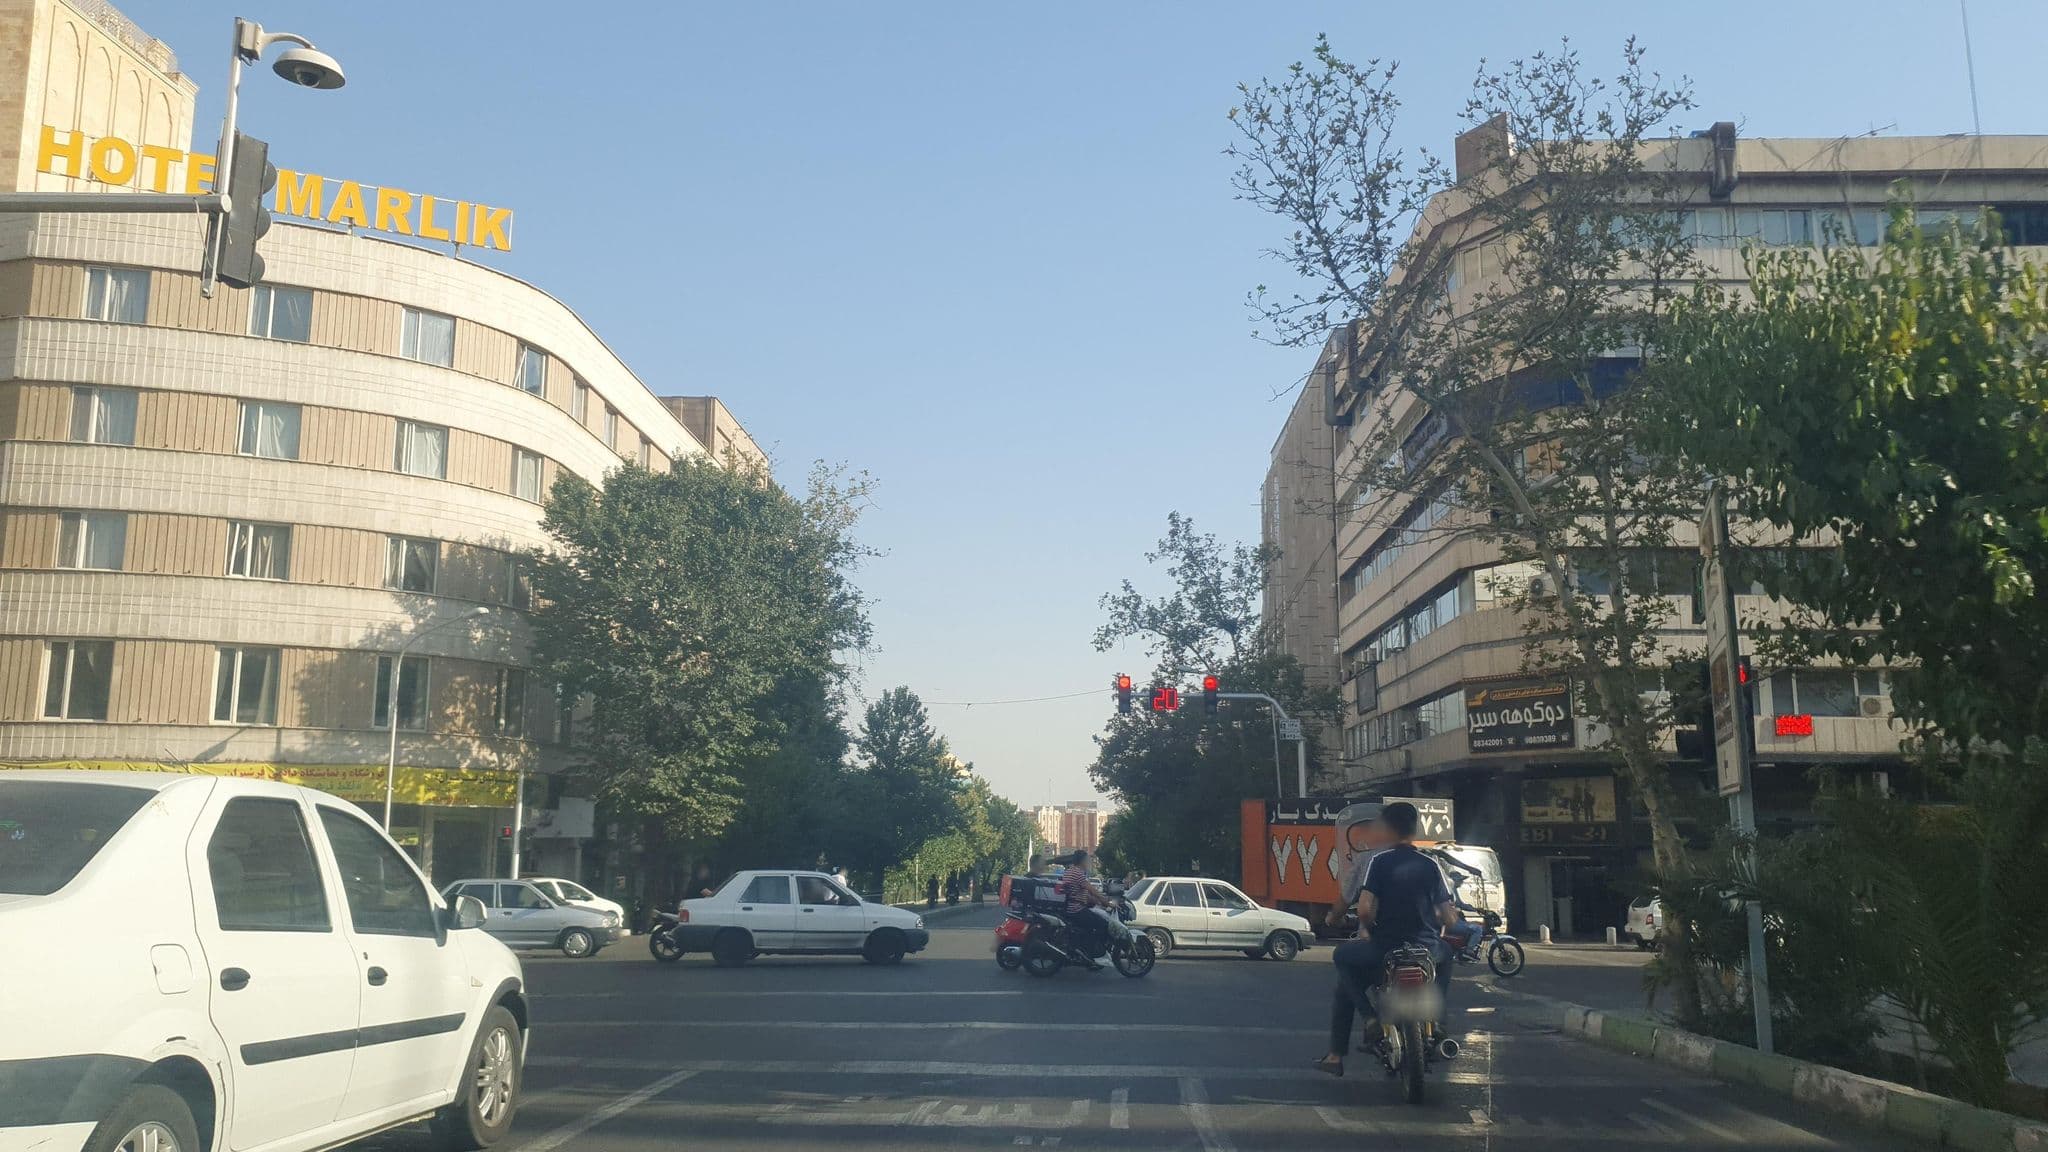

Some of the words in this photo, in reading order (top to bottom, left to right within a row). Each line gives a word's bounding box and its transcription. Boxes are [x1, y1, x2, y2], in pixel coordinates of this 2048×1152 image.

[37, 125, 219, 196] HOTE
[275, 169, 514, 251] MARLIK
[1153, 687, 1179, 710] 20
[1469, 712, 1498, 733] سیر
[1501, 701, 1565, 729] دوکوهه
[1270, 802, 1299, 824] بار
